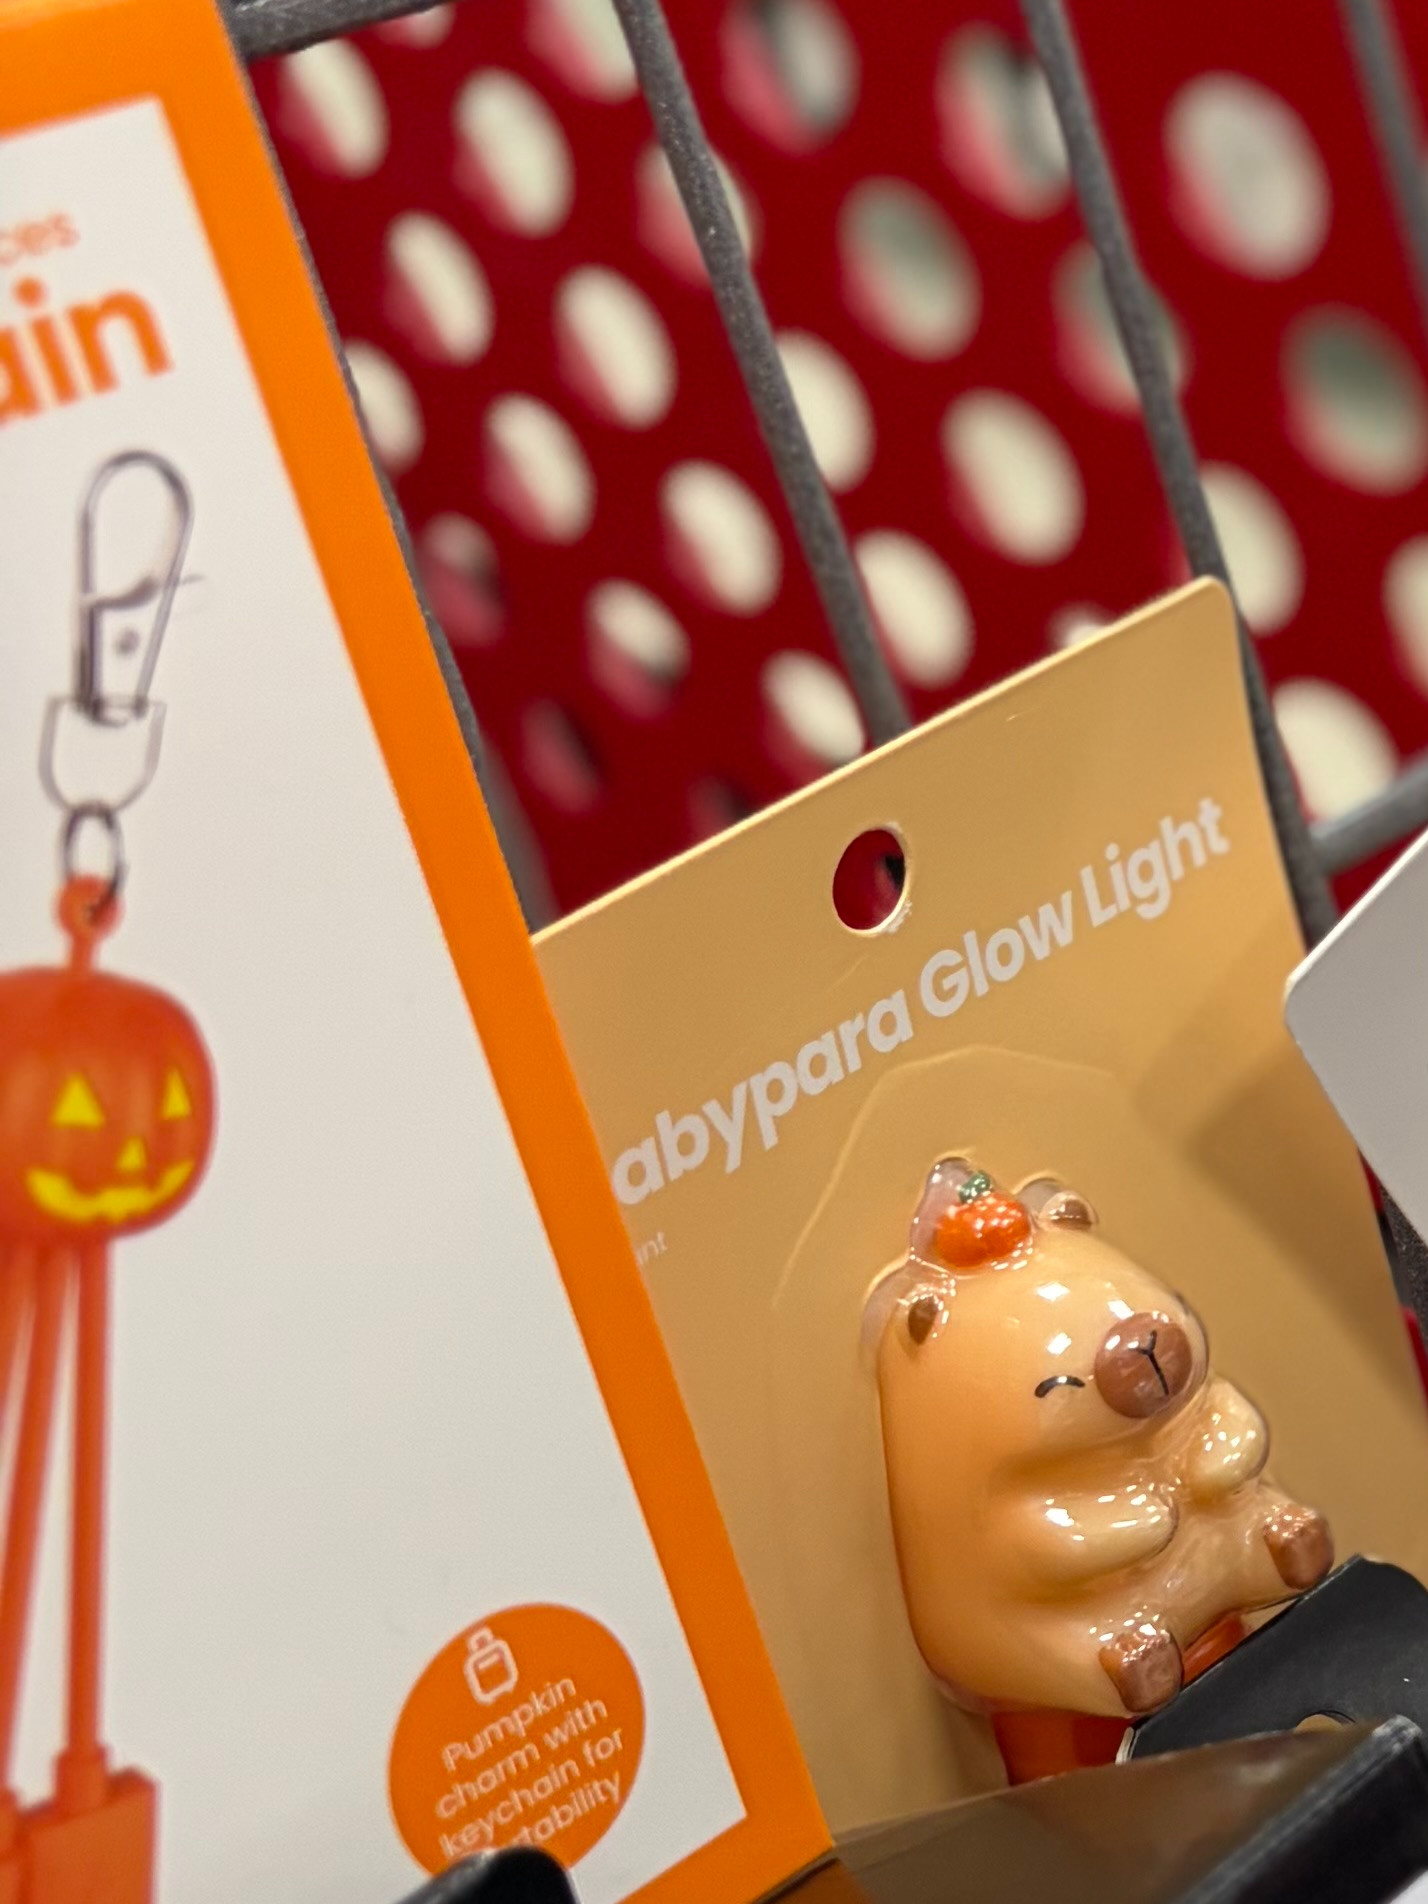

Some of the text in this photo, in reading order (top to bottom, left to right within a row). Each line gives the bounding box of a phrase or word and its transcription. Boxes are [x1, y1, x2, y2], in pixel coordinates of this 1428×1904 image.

[609, 796, 1231, 1207] abypara Glow Light
[435, 1699, 608, 1819] charm with
[441, 1677, 577, 1773] Pumpkin
[437, 1727, 623, 1858] keychain for
[510, 1770, 620, 1846] tability
